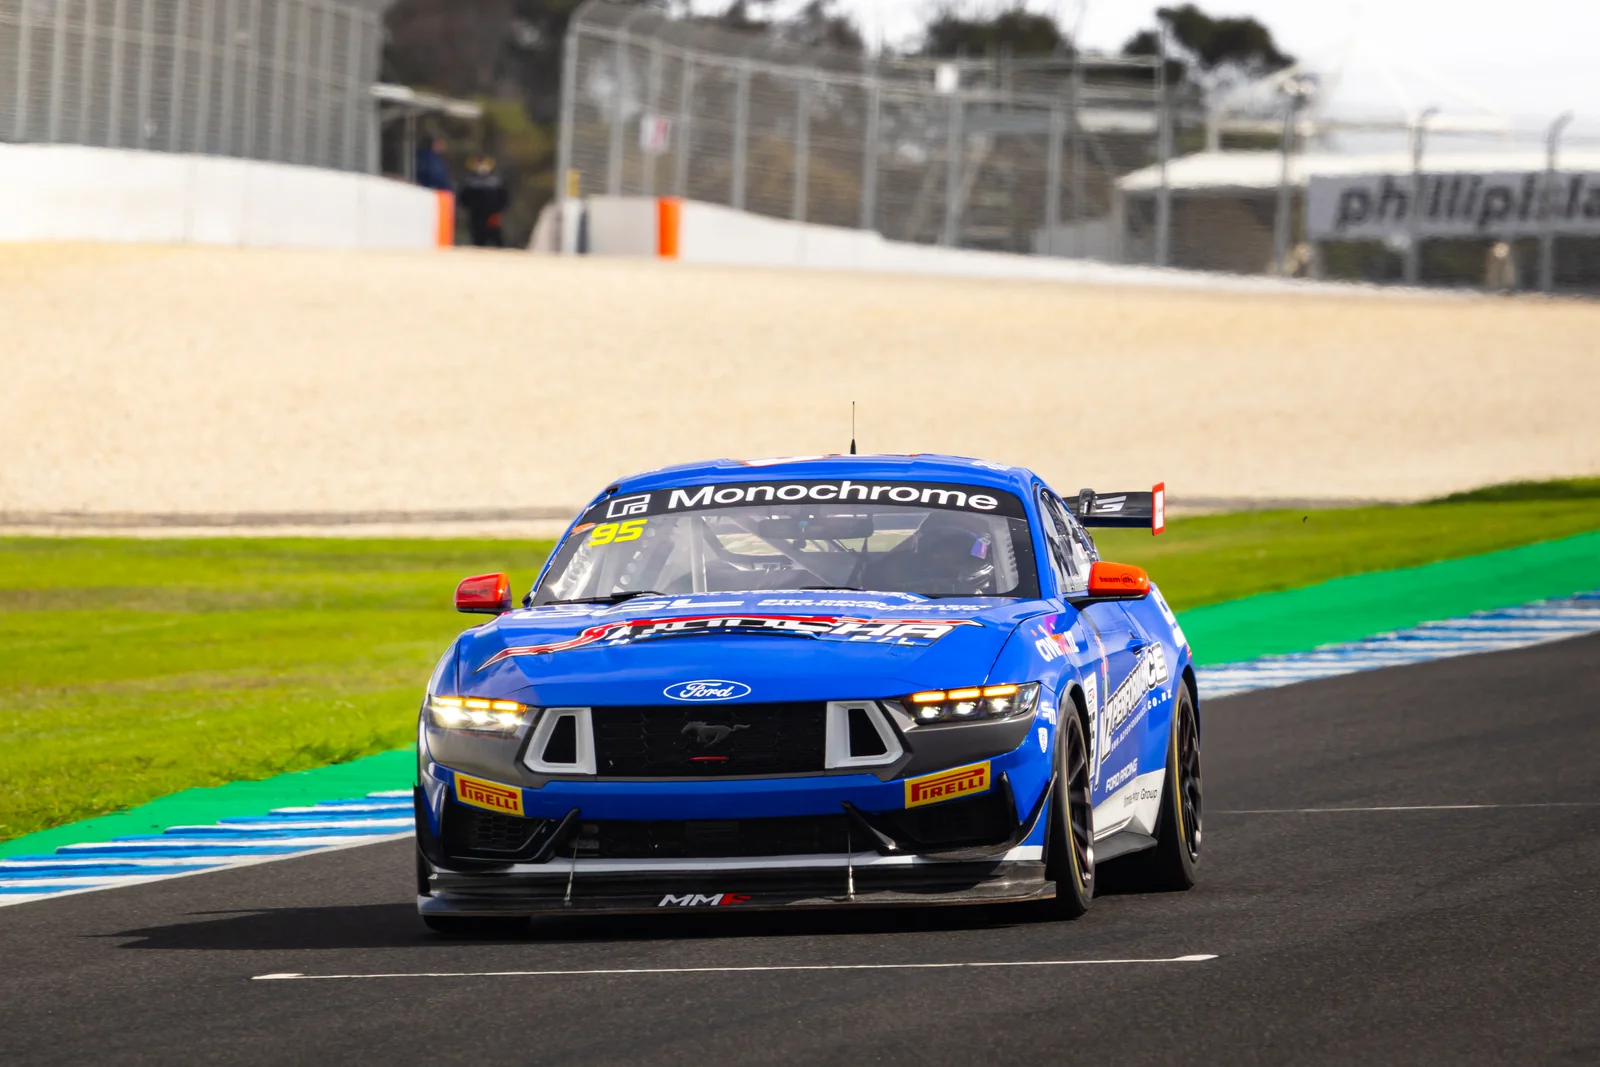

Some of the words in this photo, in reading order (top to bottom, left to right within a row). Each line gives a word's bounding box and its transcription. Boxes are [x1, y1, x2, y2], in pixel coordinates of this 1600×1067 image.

[668, 480, 998, 510] Monochrome
[588, 519, 648, 547] 95
[680, 682, 735, 698] Ford
[459, 778, 519, 811] PIRELLI
[911, 767, 985, 802] PIRELLI
[1140, 788, 1158, 801] Group
